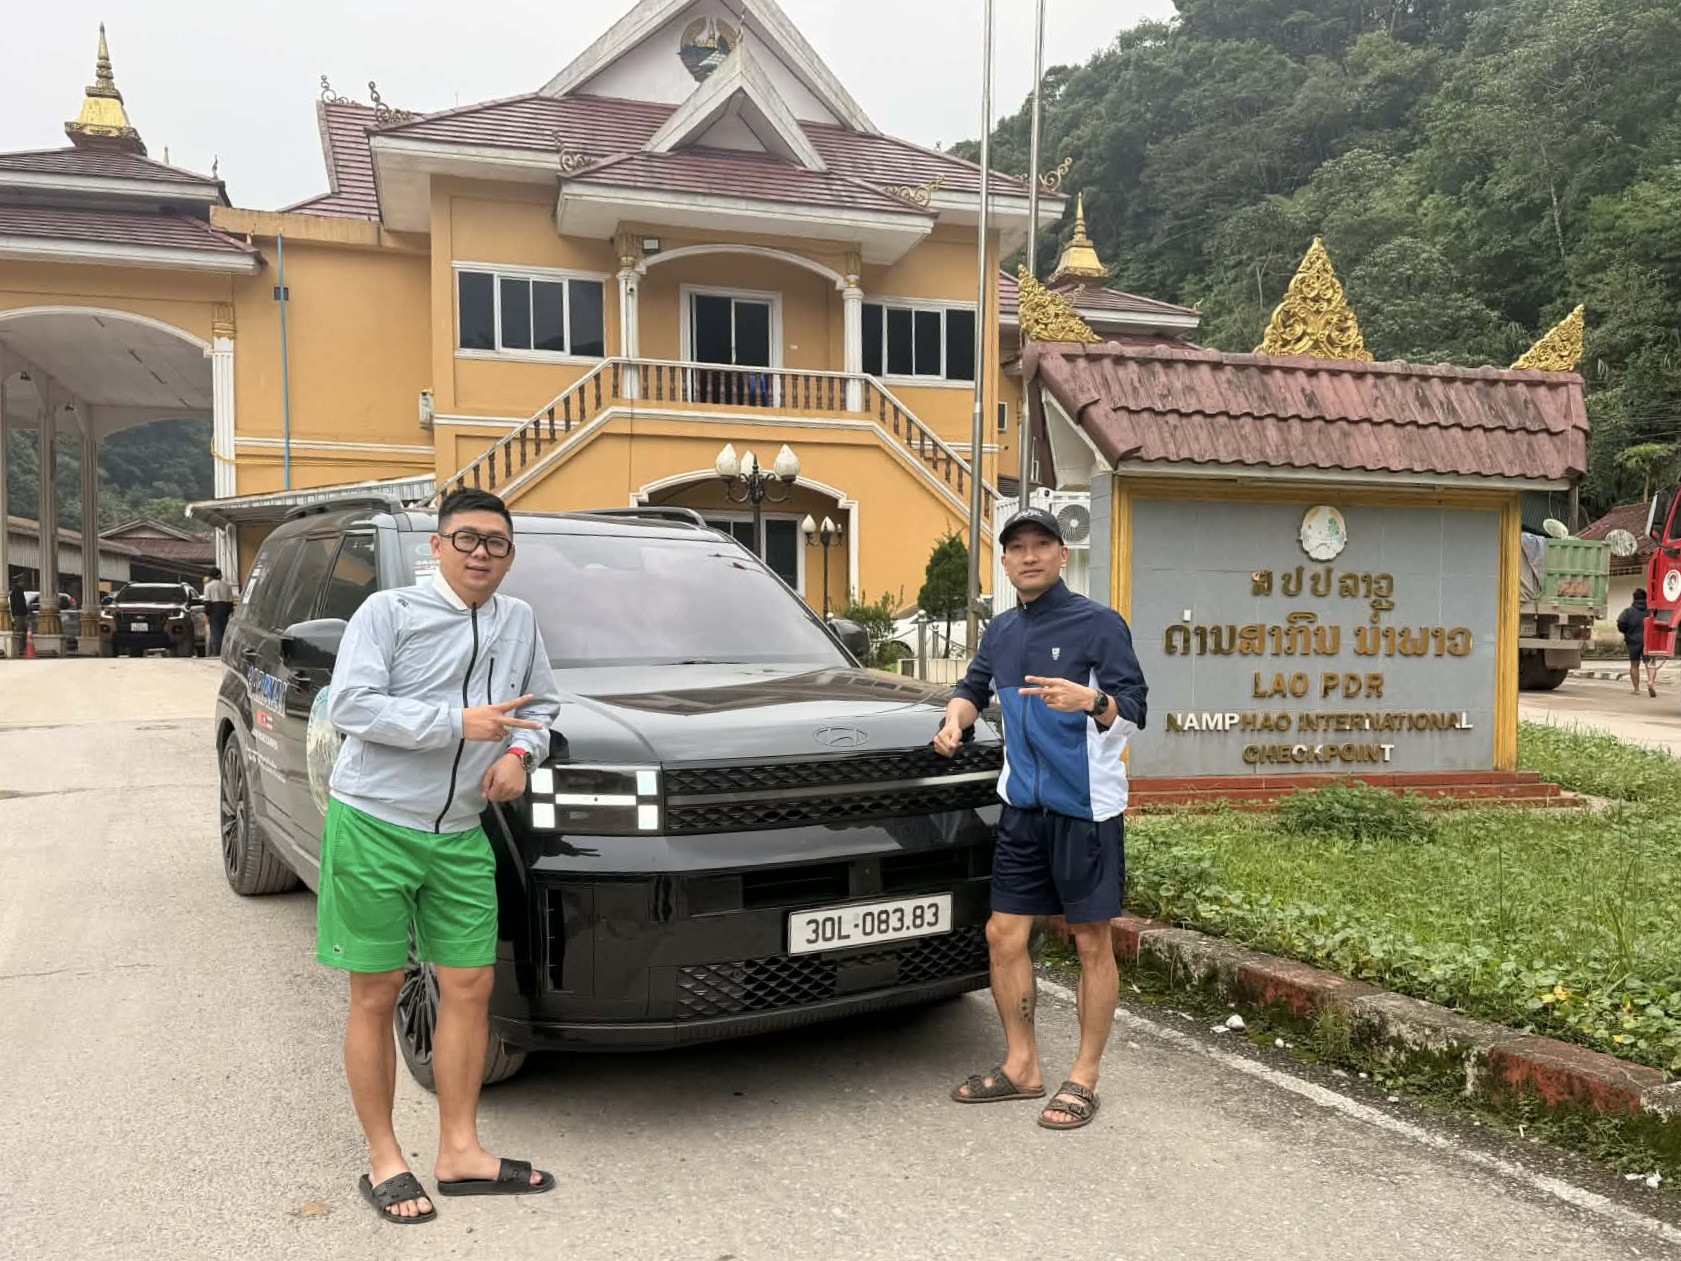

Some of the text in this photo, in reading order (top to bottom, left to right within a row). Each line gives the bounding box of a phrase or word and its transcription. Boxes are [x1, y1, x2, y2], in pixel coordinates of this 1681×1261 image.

[1252, 671, 1385, 699] LAO PDR
[1297, 712, 1473, 732] INTERNATIONAL
[1241, 743, 1395, 764] CHECKPOINT
[805, 902, 940, 945] 30L-083.83
